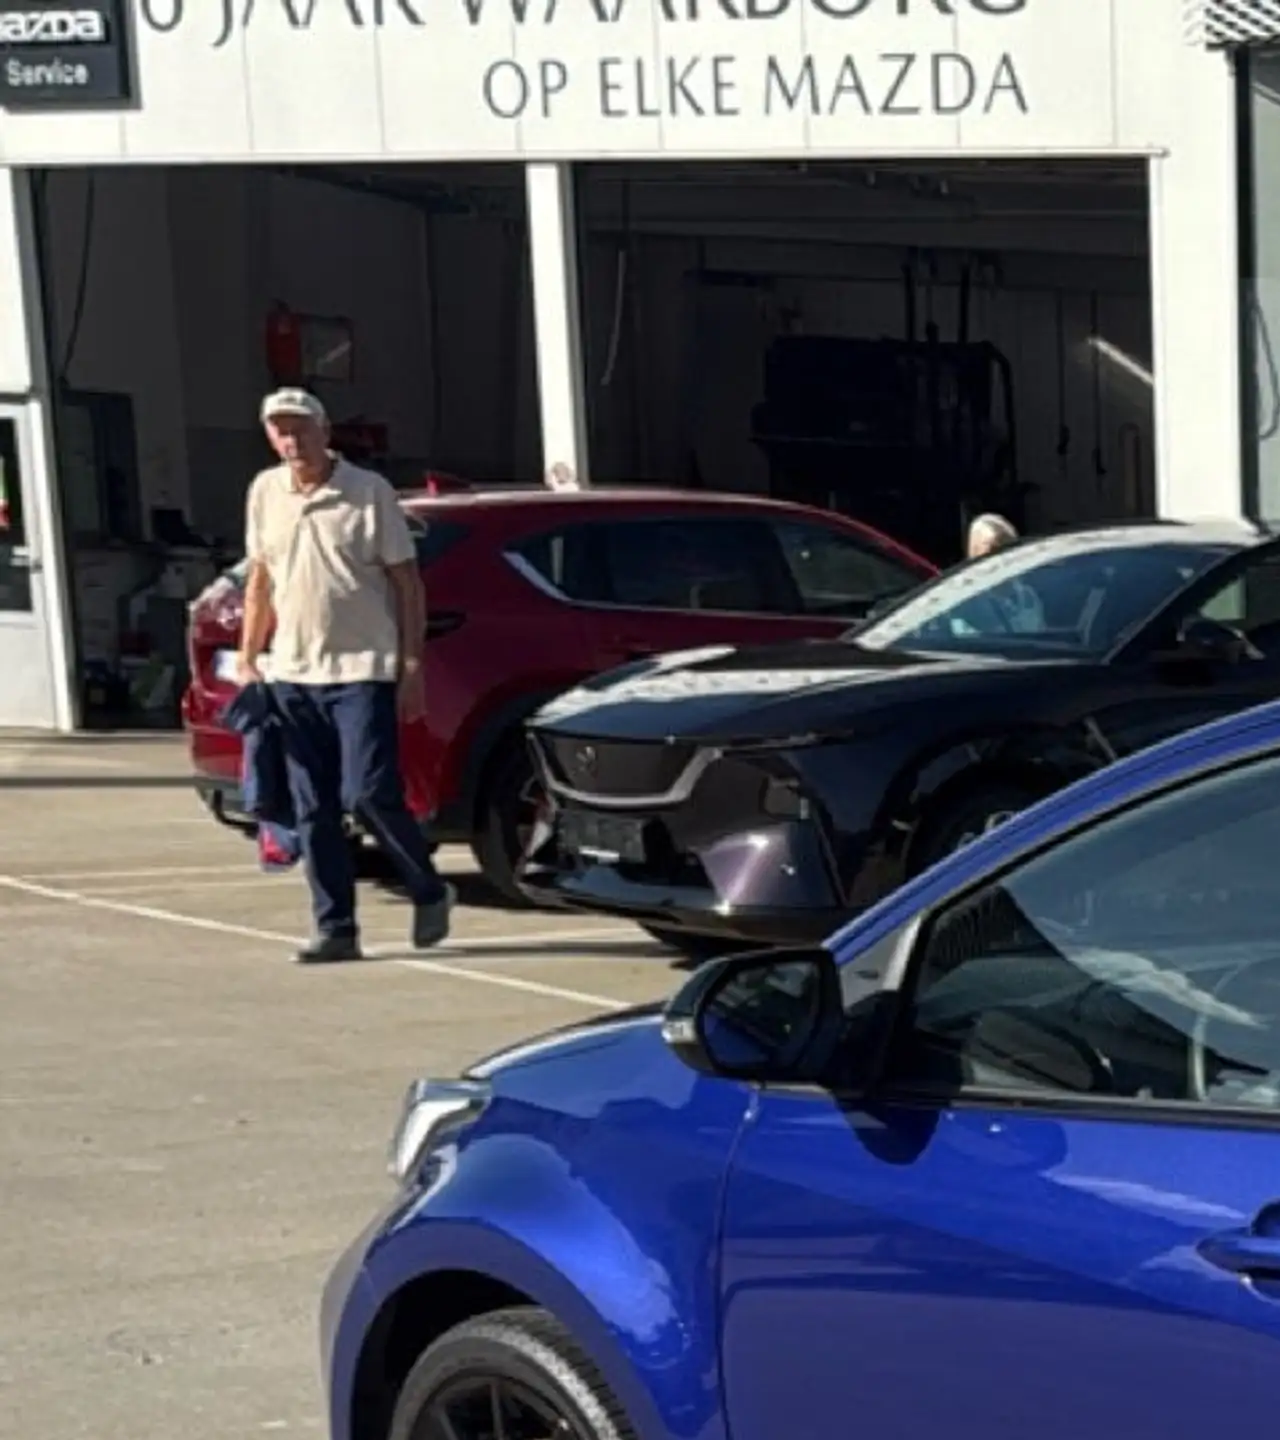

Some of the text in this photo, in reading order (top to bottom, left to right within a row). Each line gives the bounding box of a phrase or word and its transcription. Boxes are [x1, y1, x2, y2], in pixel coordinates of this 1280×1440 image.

[0, 10, 103, 41] azda
[6, 57, 88, 86] Service
[482, 52, 1029, 118] OP ELKE MAZDA
